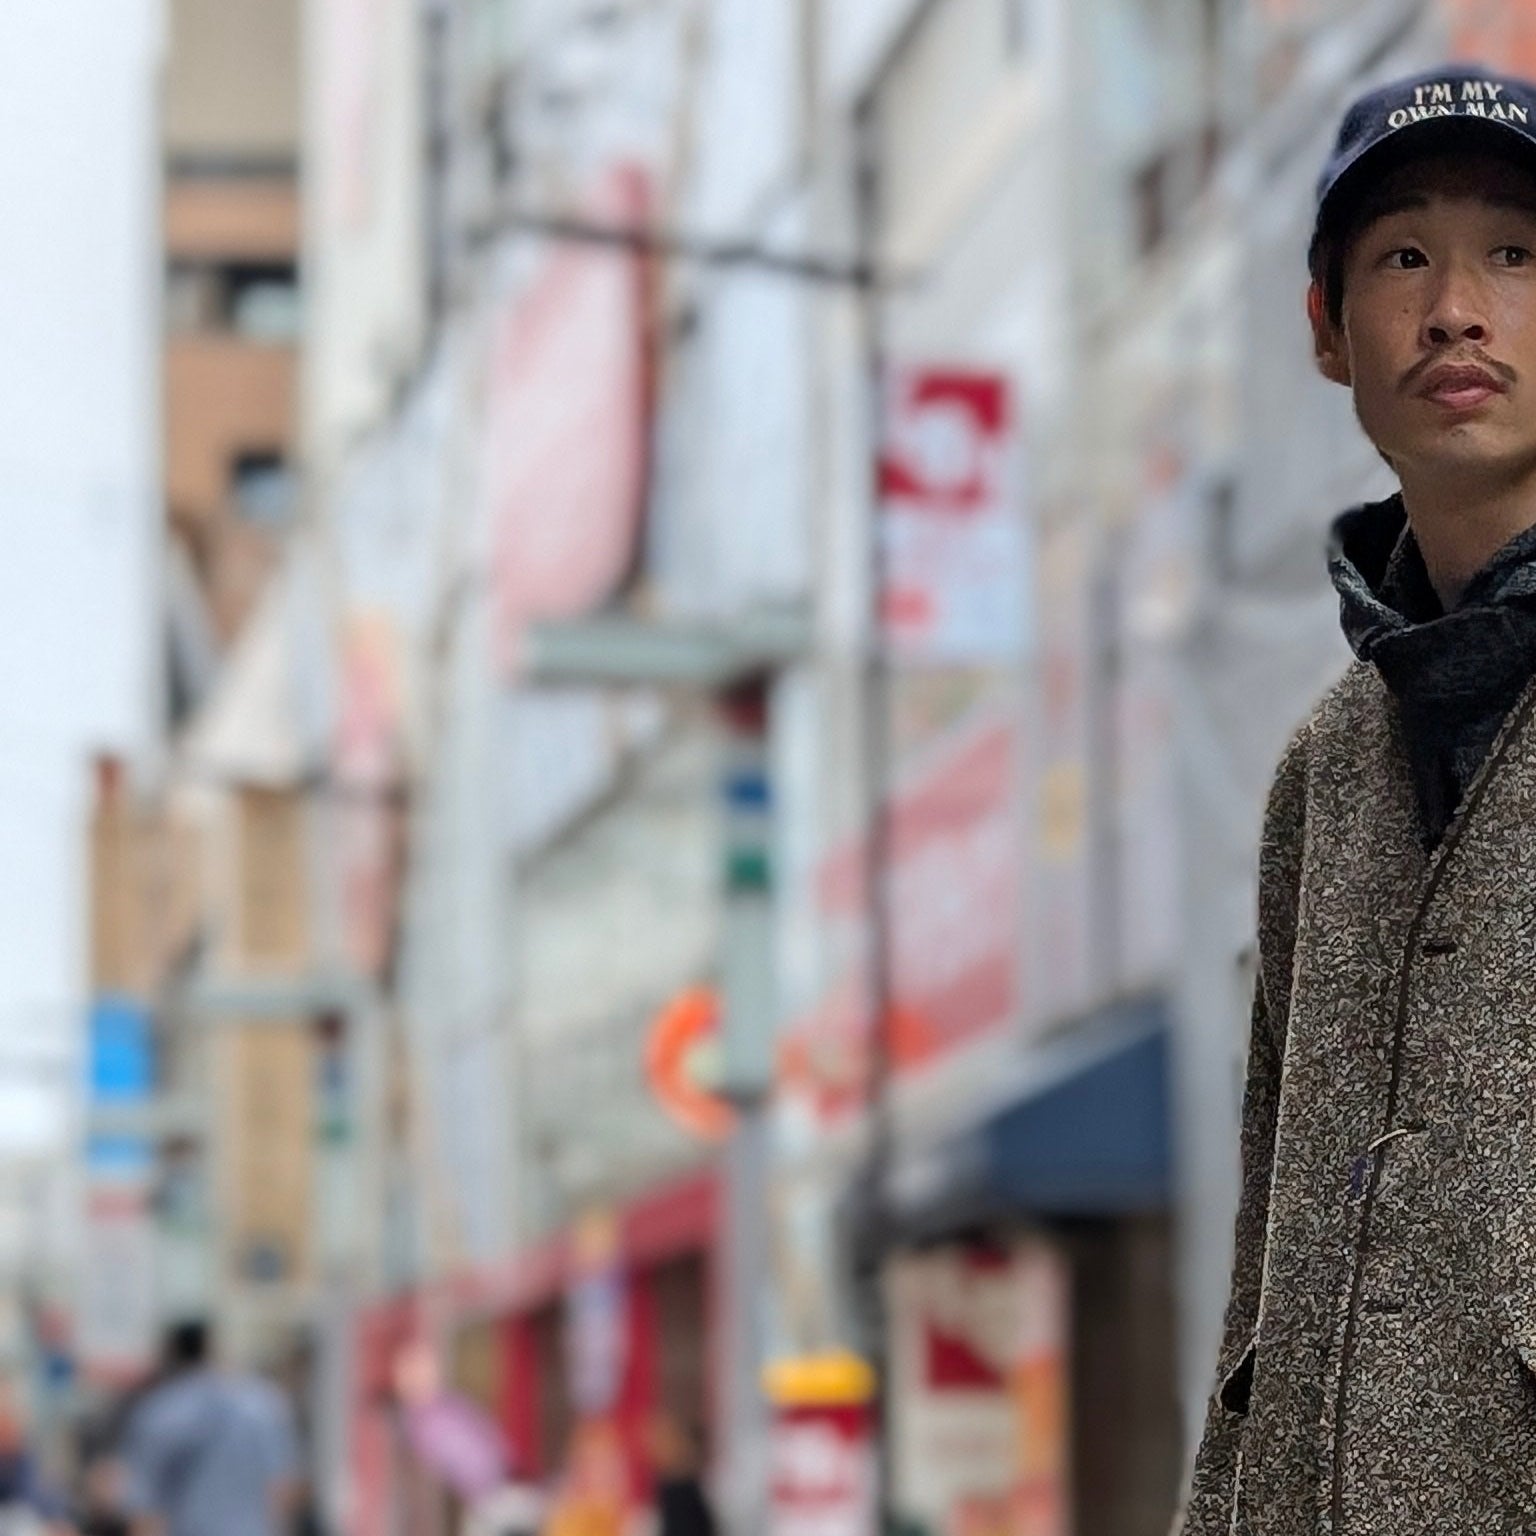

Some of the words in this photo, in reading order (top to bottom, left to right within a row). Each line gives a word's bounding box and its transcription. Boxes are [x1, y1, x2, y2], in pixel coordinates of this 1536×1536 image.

[1415, 83, 1453, 105] I'M
[1460, 81, 1503, 101] MY
[1388, 103, 1456, 129] OWN
[1466, 102, 1528, 124] MAN
